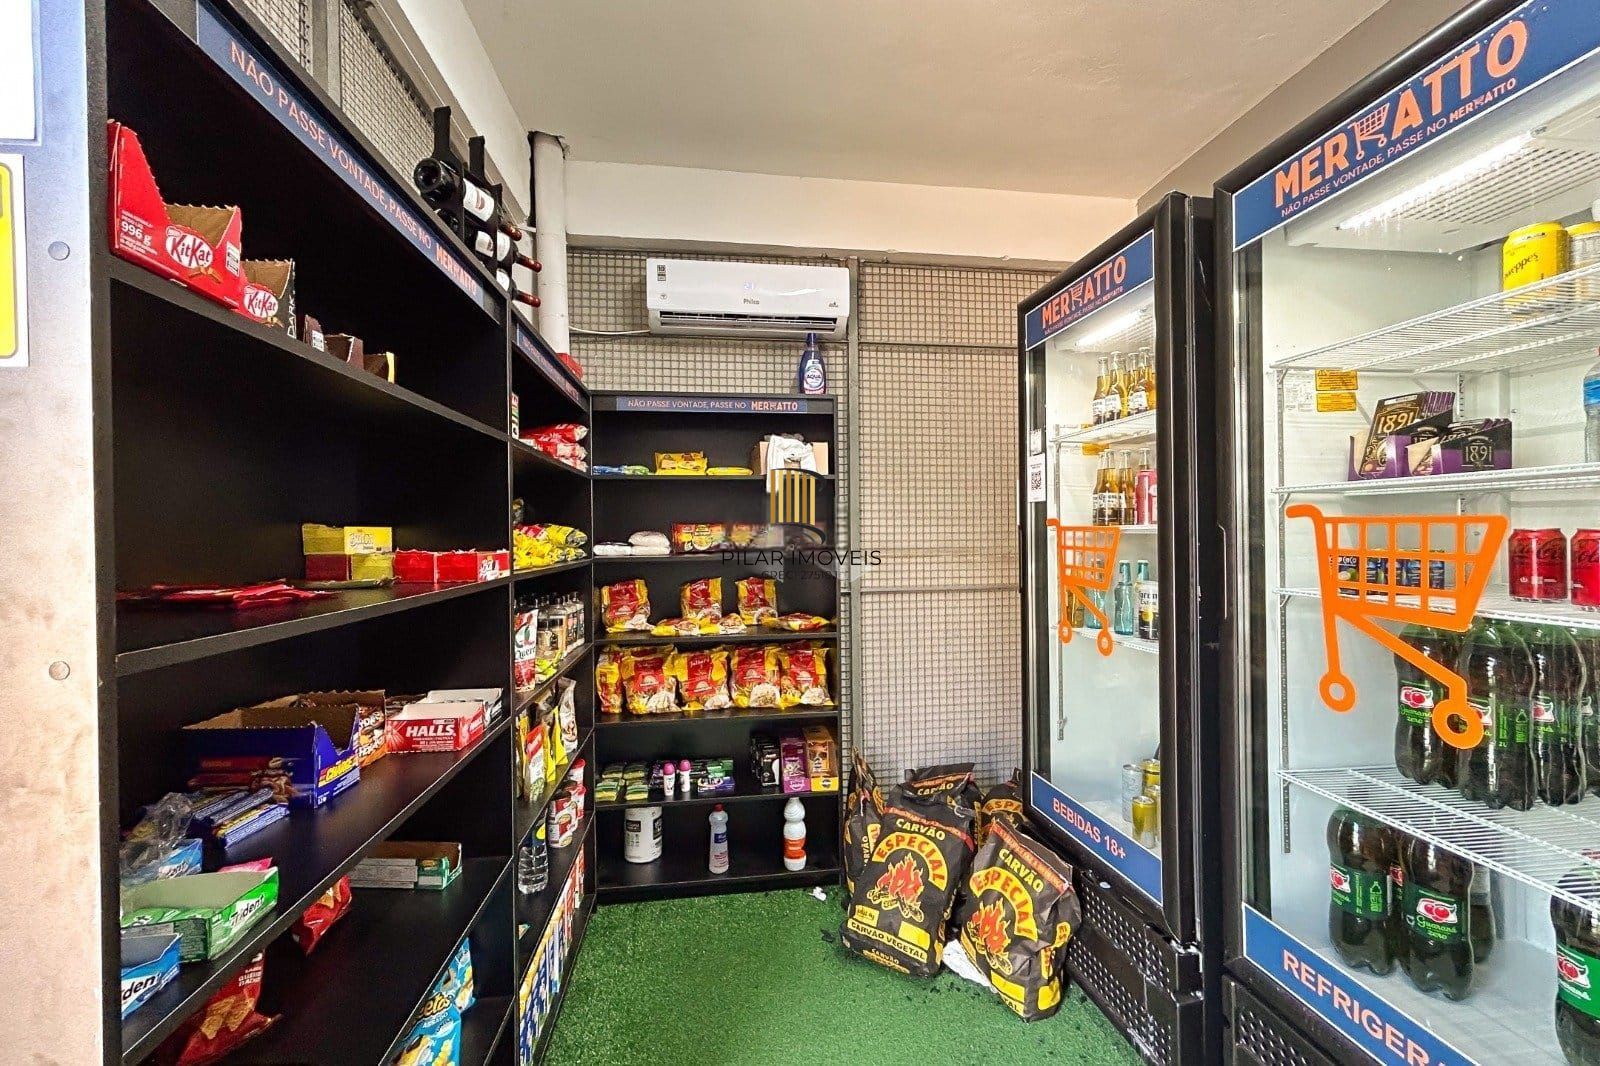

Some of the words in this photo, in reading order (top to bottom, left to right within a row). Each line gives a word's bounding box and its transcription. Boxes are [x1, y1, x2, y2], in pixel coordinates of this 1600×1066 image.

[231, 39, 274, 97] NÃO
[278, 92, 326, 149] PASSE
[329, 144, 389, 212] VONTADE,
[389, 201, 418, 239] PASSE
[418, 228, 433, 249] NO
[1280, 200, 1302, 218] NÃO
[1302, 184, 1331, 208] PASSE
[1332, 155, 1385, 189] VONTADE,
[1387, 130, 1424, 159] PASSE
[1426, 117, 1447, 136] NO
[121, 220, 143, 240] 996
[170, 233, 212, 268] KitKat
[247, 291, 278, 317] KitKat
[647, 400, 671, 409] PASSE
[734, 402, 747, 410] NO
[1465, 445, 1492, 463] 1891
[405, 724, 456, 738] HALLS
[896, 818, 946, 841] CARVÃO
[1052, 797, 1101, 844] BEBIDAS
[1104, 835, 1127, 860] 18+
[876, 834, 946, 886] ESPECIAL
[999, 848, 1045, 893] CARVÃO
[231, 894, 265, 927] Trident
[974, 869, 1034, 935] ESPECIAL
[851, 921, 885, 941] CARVÃO
[886, 936, 925, 960] VEGETAL
[1416, 915, 1458, 934] Guaraná
[1283, 949, 1446, 1066] REFRIGER
